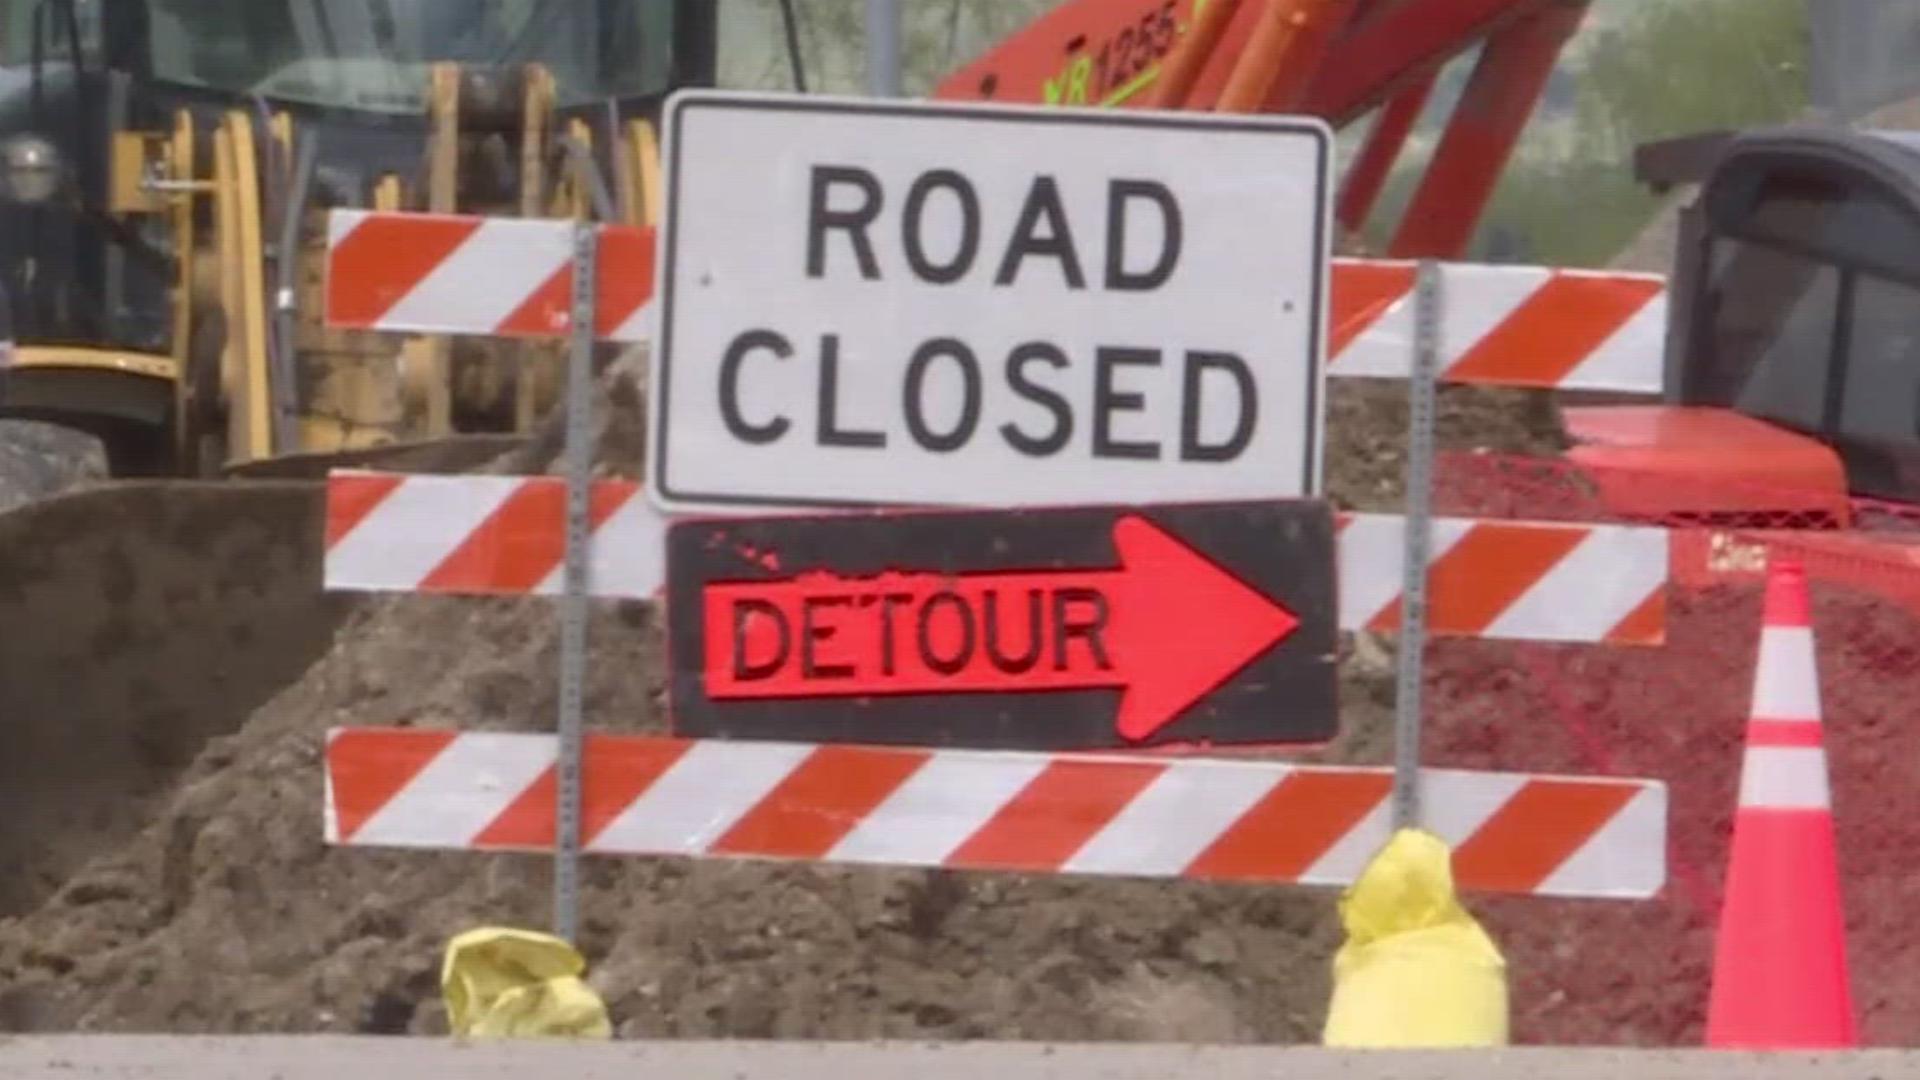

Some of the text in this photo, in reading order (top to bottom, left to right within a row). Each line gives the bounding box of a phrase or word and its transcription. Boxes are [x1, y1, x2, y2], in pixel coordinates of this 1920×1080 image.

[806, 165, 1182, 291] ROAD
[718, 329, 1259, 463] CLOSED
[732, 588, 1113, 682] DETOUR
